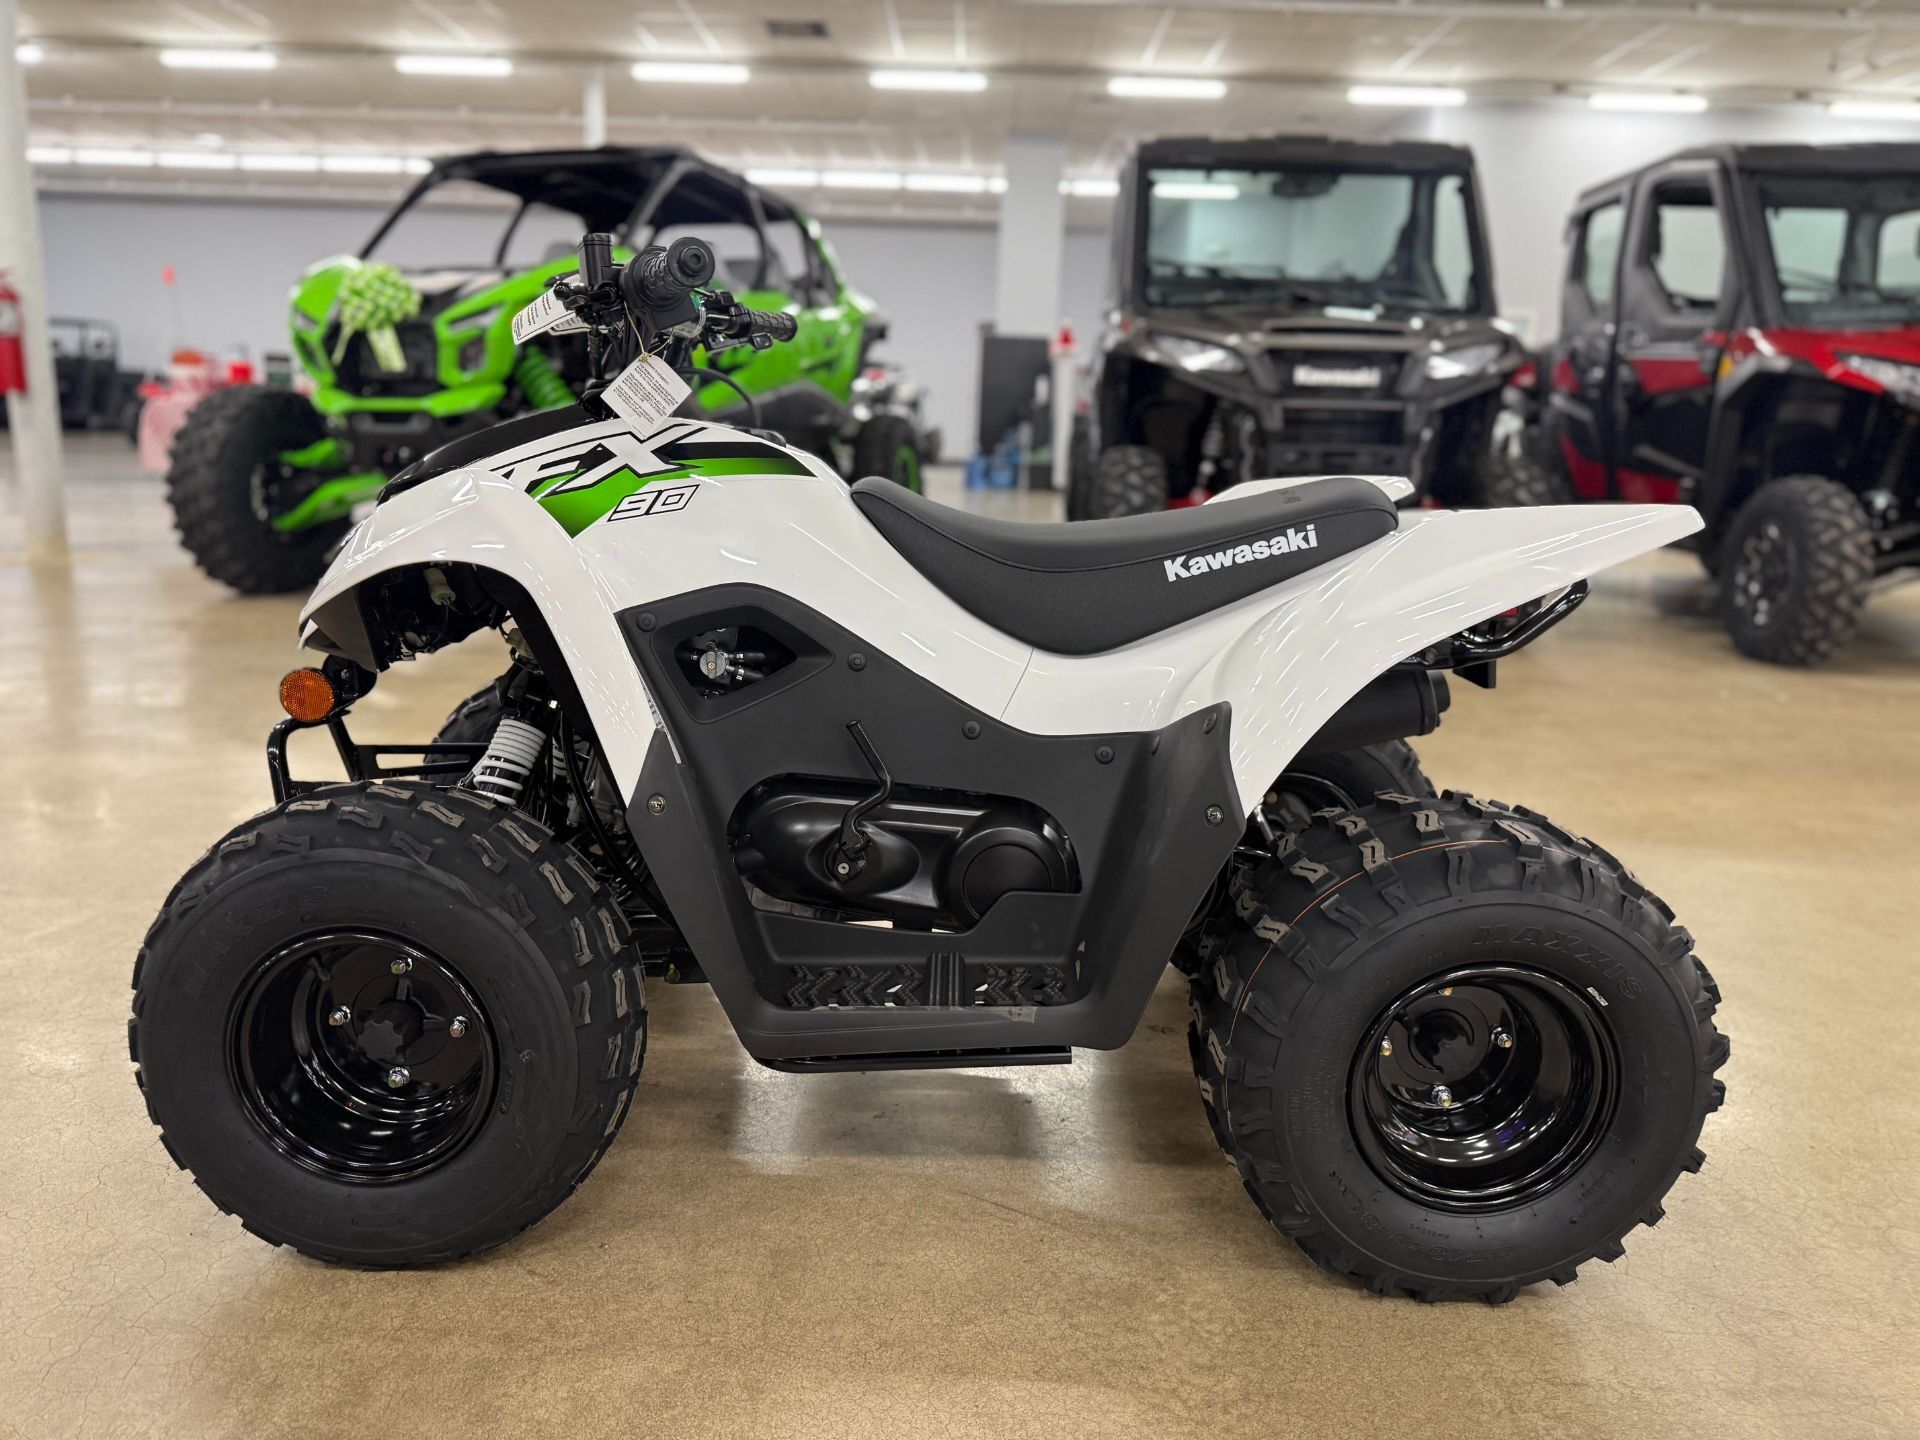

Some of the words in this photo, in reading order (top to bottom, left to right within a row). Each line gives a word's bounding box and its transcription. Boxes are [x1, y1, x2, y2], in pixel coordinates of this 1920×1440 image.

[607, 483, 701, 523] 90
[1163, 523, 1319, 583] Kawasaki
[1472, 922, 1645, 1000] MAXXIS
